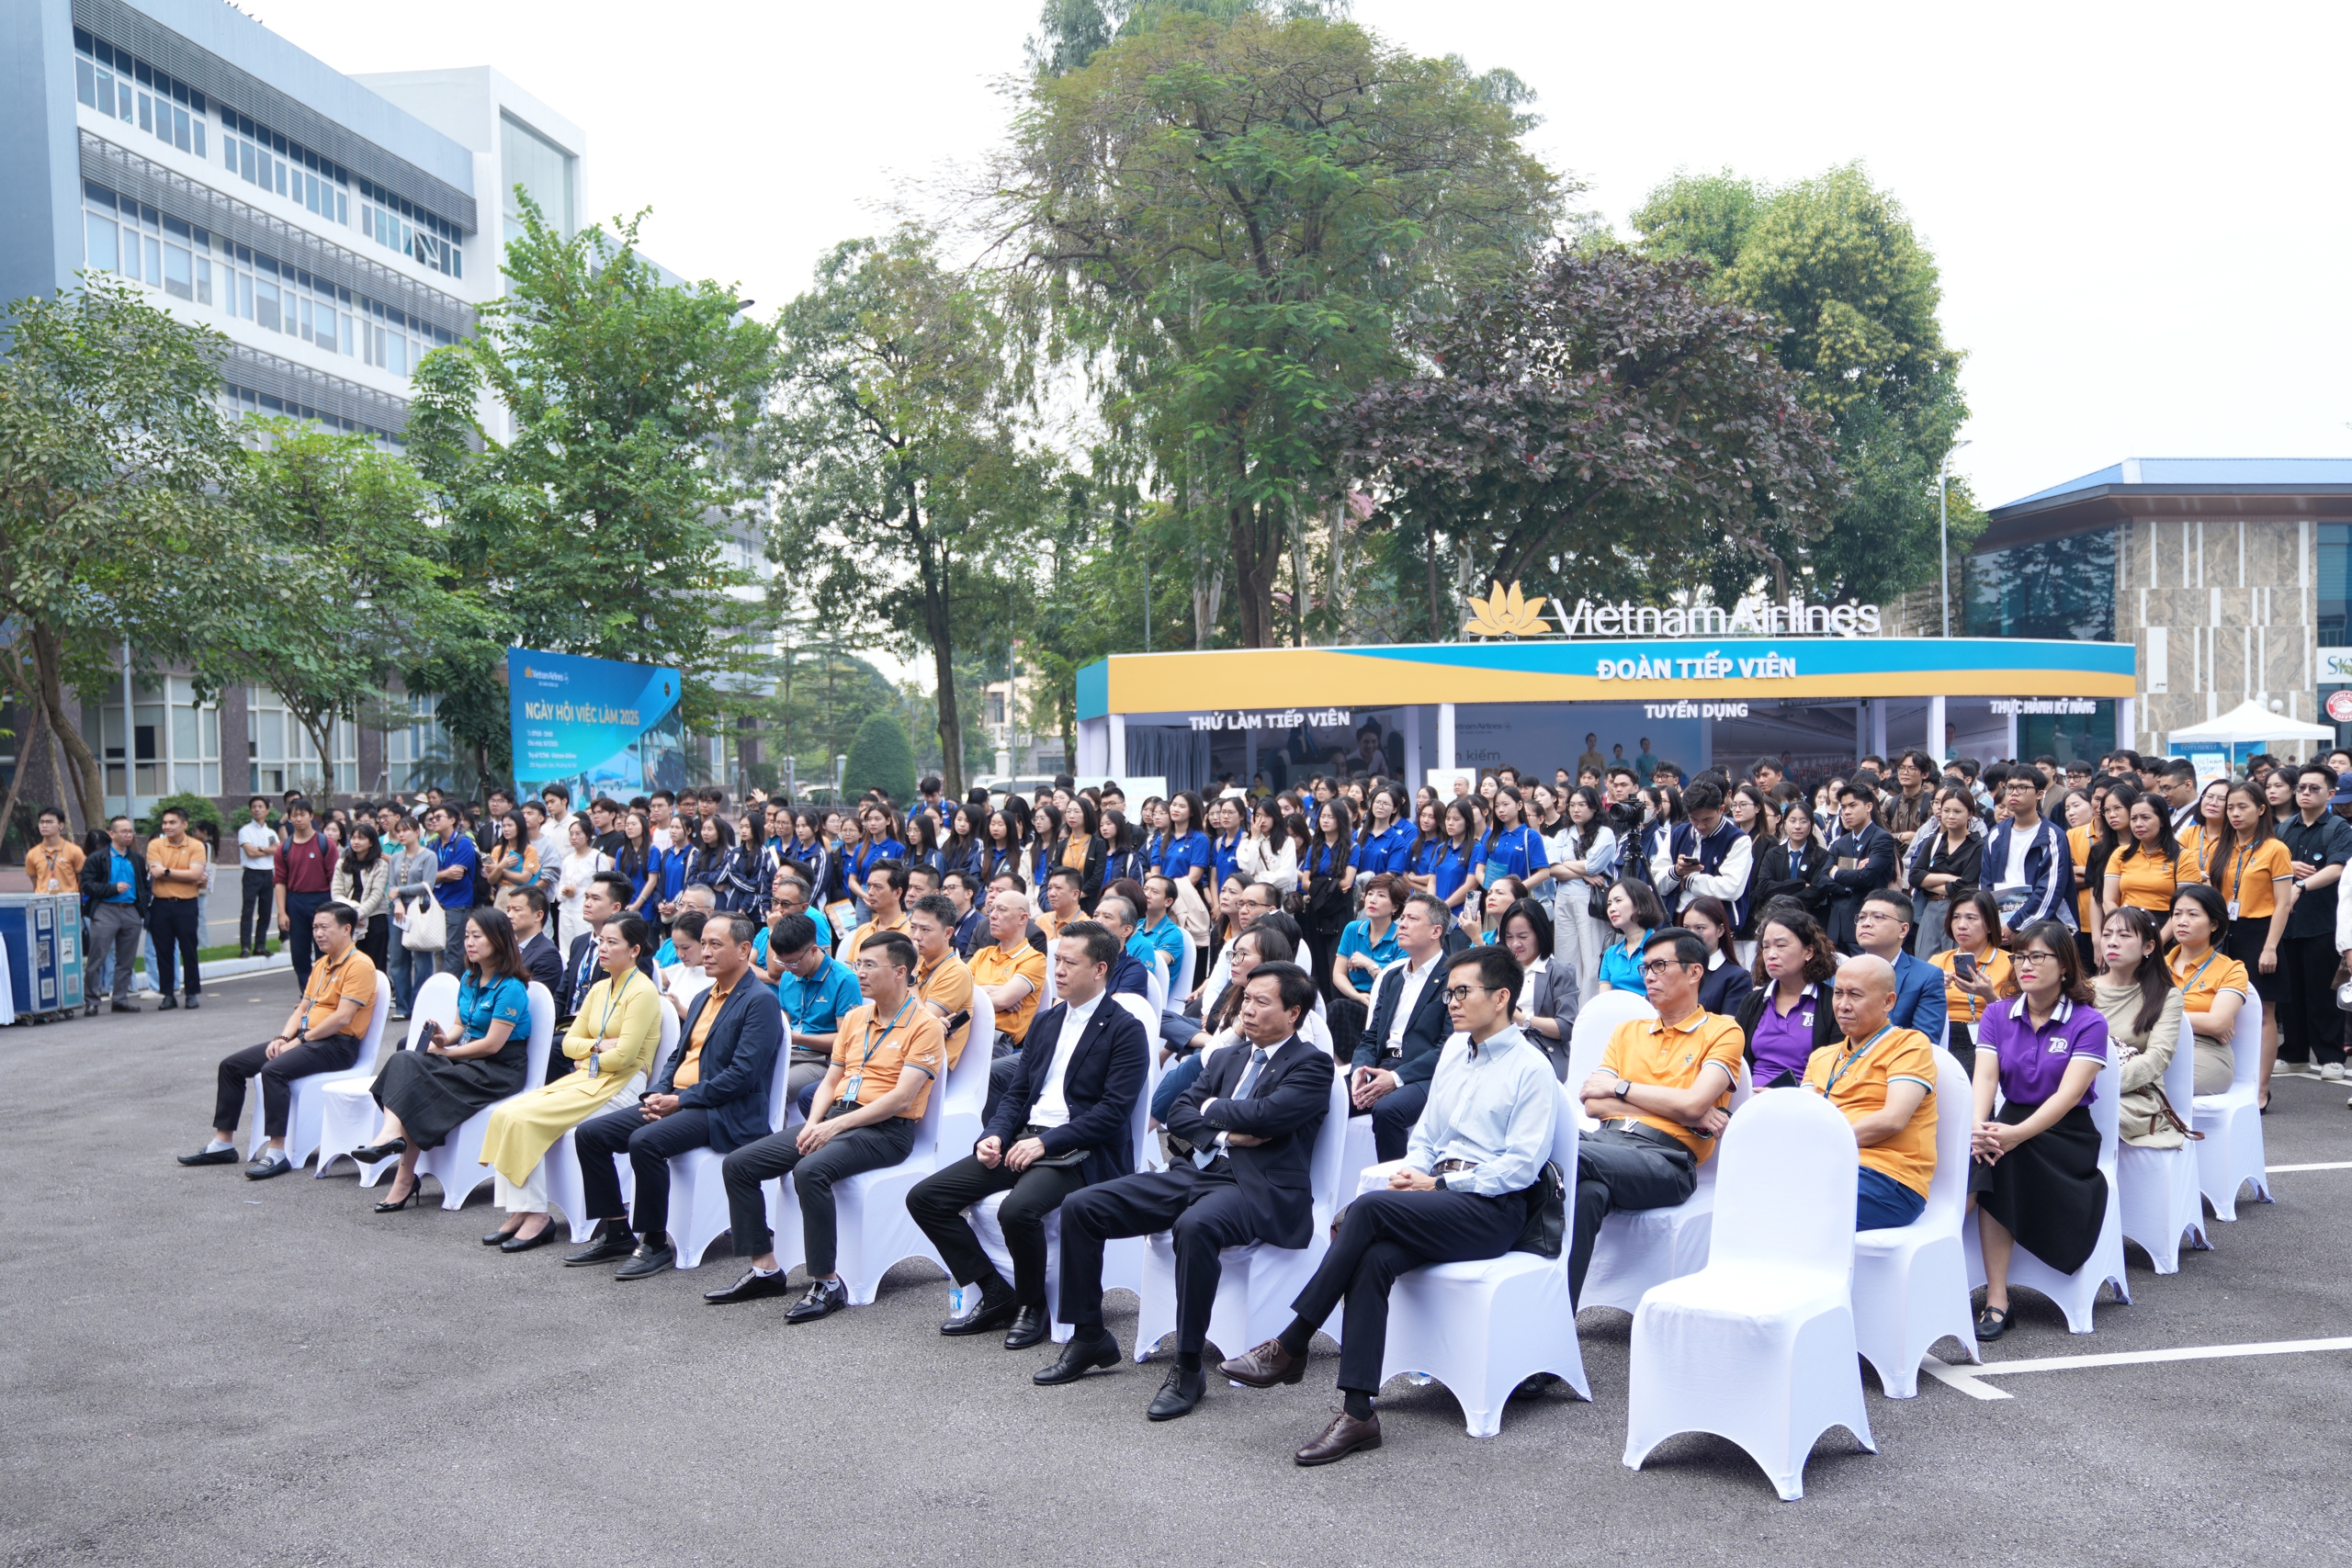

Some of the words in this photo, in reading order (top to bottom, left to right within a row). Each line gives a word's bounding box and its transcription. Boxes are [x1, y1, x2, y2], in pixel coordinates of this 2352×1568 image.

[1596, 653, 1671, 681] ĐOÀN
[1676, 649, 1734, 680] TIẾP
[1737, 650, 1796, 679] VIÊN
[526, 699, 554, 720] NGÀY
[556, 701, 574, 726] HỘI
[575, 703, 597, 727] VIỆC
[599, 705, 618, 725] LÀM
[619, 709, 639, 726] 2025
[1644, 699, 1698, 718] TUYỂN
[1702, 703, 1748, 721] DỤNG
[2023, 696, 2053, 715] HÀNH
[1189, 711, 1225, 730] THỬ
[1227, 711, 1262, 730] LÀM
[1265, 708, 1305, 728] TIẾP
[1307, 707, 1351, 727] VIÊN
[1466, 748, 1500, 761] kiếm
